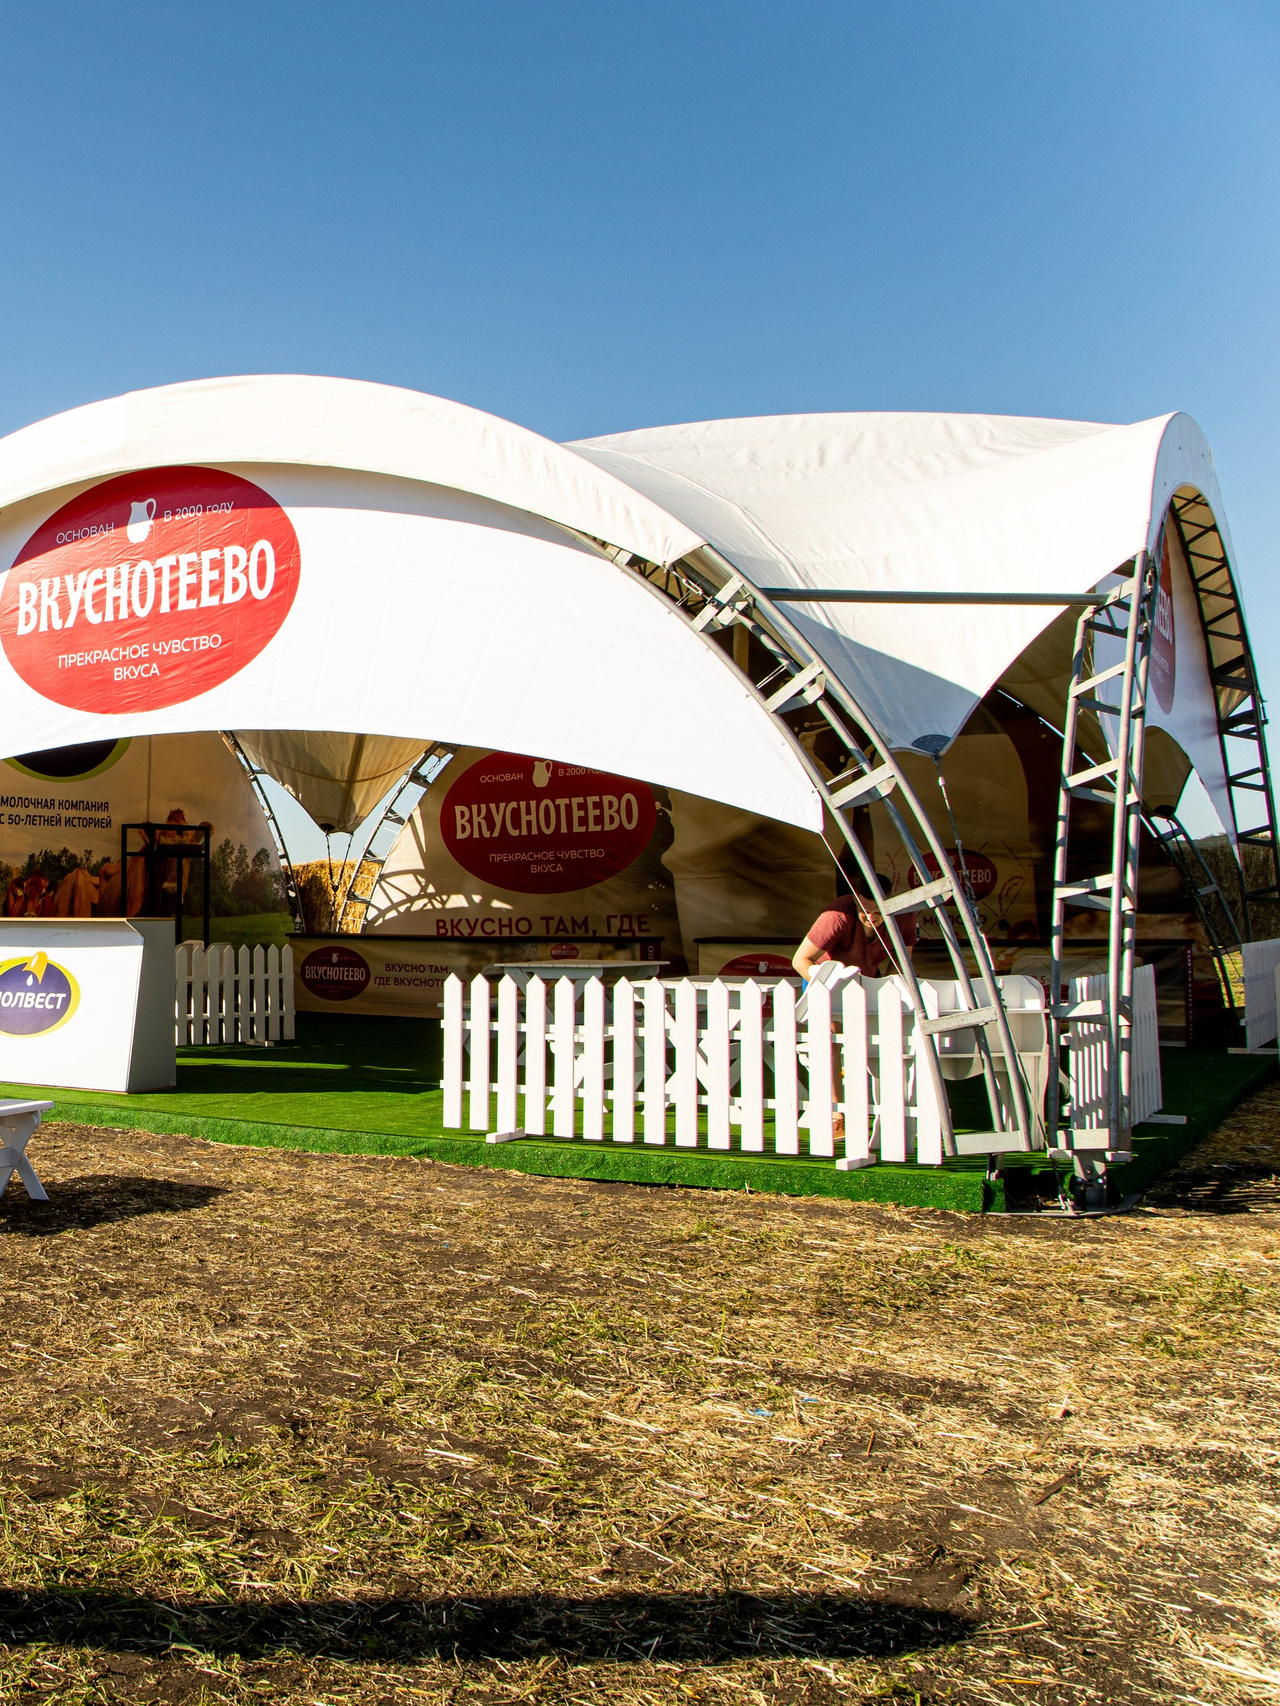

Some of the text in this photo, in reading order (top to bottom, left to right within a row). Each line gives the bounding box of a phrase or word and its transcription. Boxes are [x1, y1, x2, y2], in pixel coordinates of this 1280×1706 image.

[56, 501, 235, 544] ОСНОВАН В 2000 году
[17, 539, 276, 636] ВКУСНОТЕЕВО
[58, 633, 223, 669] ПРЕКРАСНОЕ ЧУВСТВО
[114, 663, 160, 681] ВКУСА
[480, 772, 524, 784] ОСНОВАН
[558, 768, 564, 777] В
[566, 767, 586, 777] 2000
[0, 795, 109, 813] МОЛОЧНАЯ КОМПАНИЯ
[8, 813, 61, 827] 50-ЛЕТНЕЙ
[64, 815, 112, 829] ИСТОРИЕЙ
[454, 793, 639, 840] ВКУСНОТЕЕВО
[489, 848, 605, 863] ПРЕКРАСНОЕ ЧУВСТВО
[530, 863, 563, 874] ВКУСА
[435, 914, 651, 937] ВКУСНО ТАМ, ГДЕ
[305, 965, 366, 982] ВКУСНОТЕЕВО
[384, 963, 426, 974] ВКУСНО
[374, 976, 391, 987] ГДЕ
